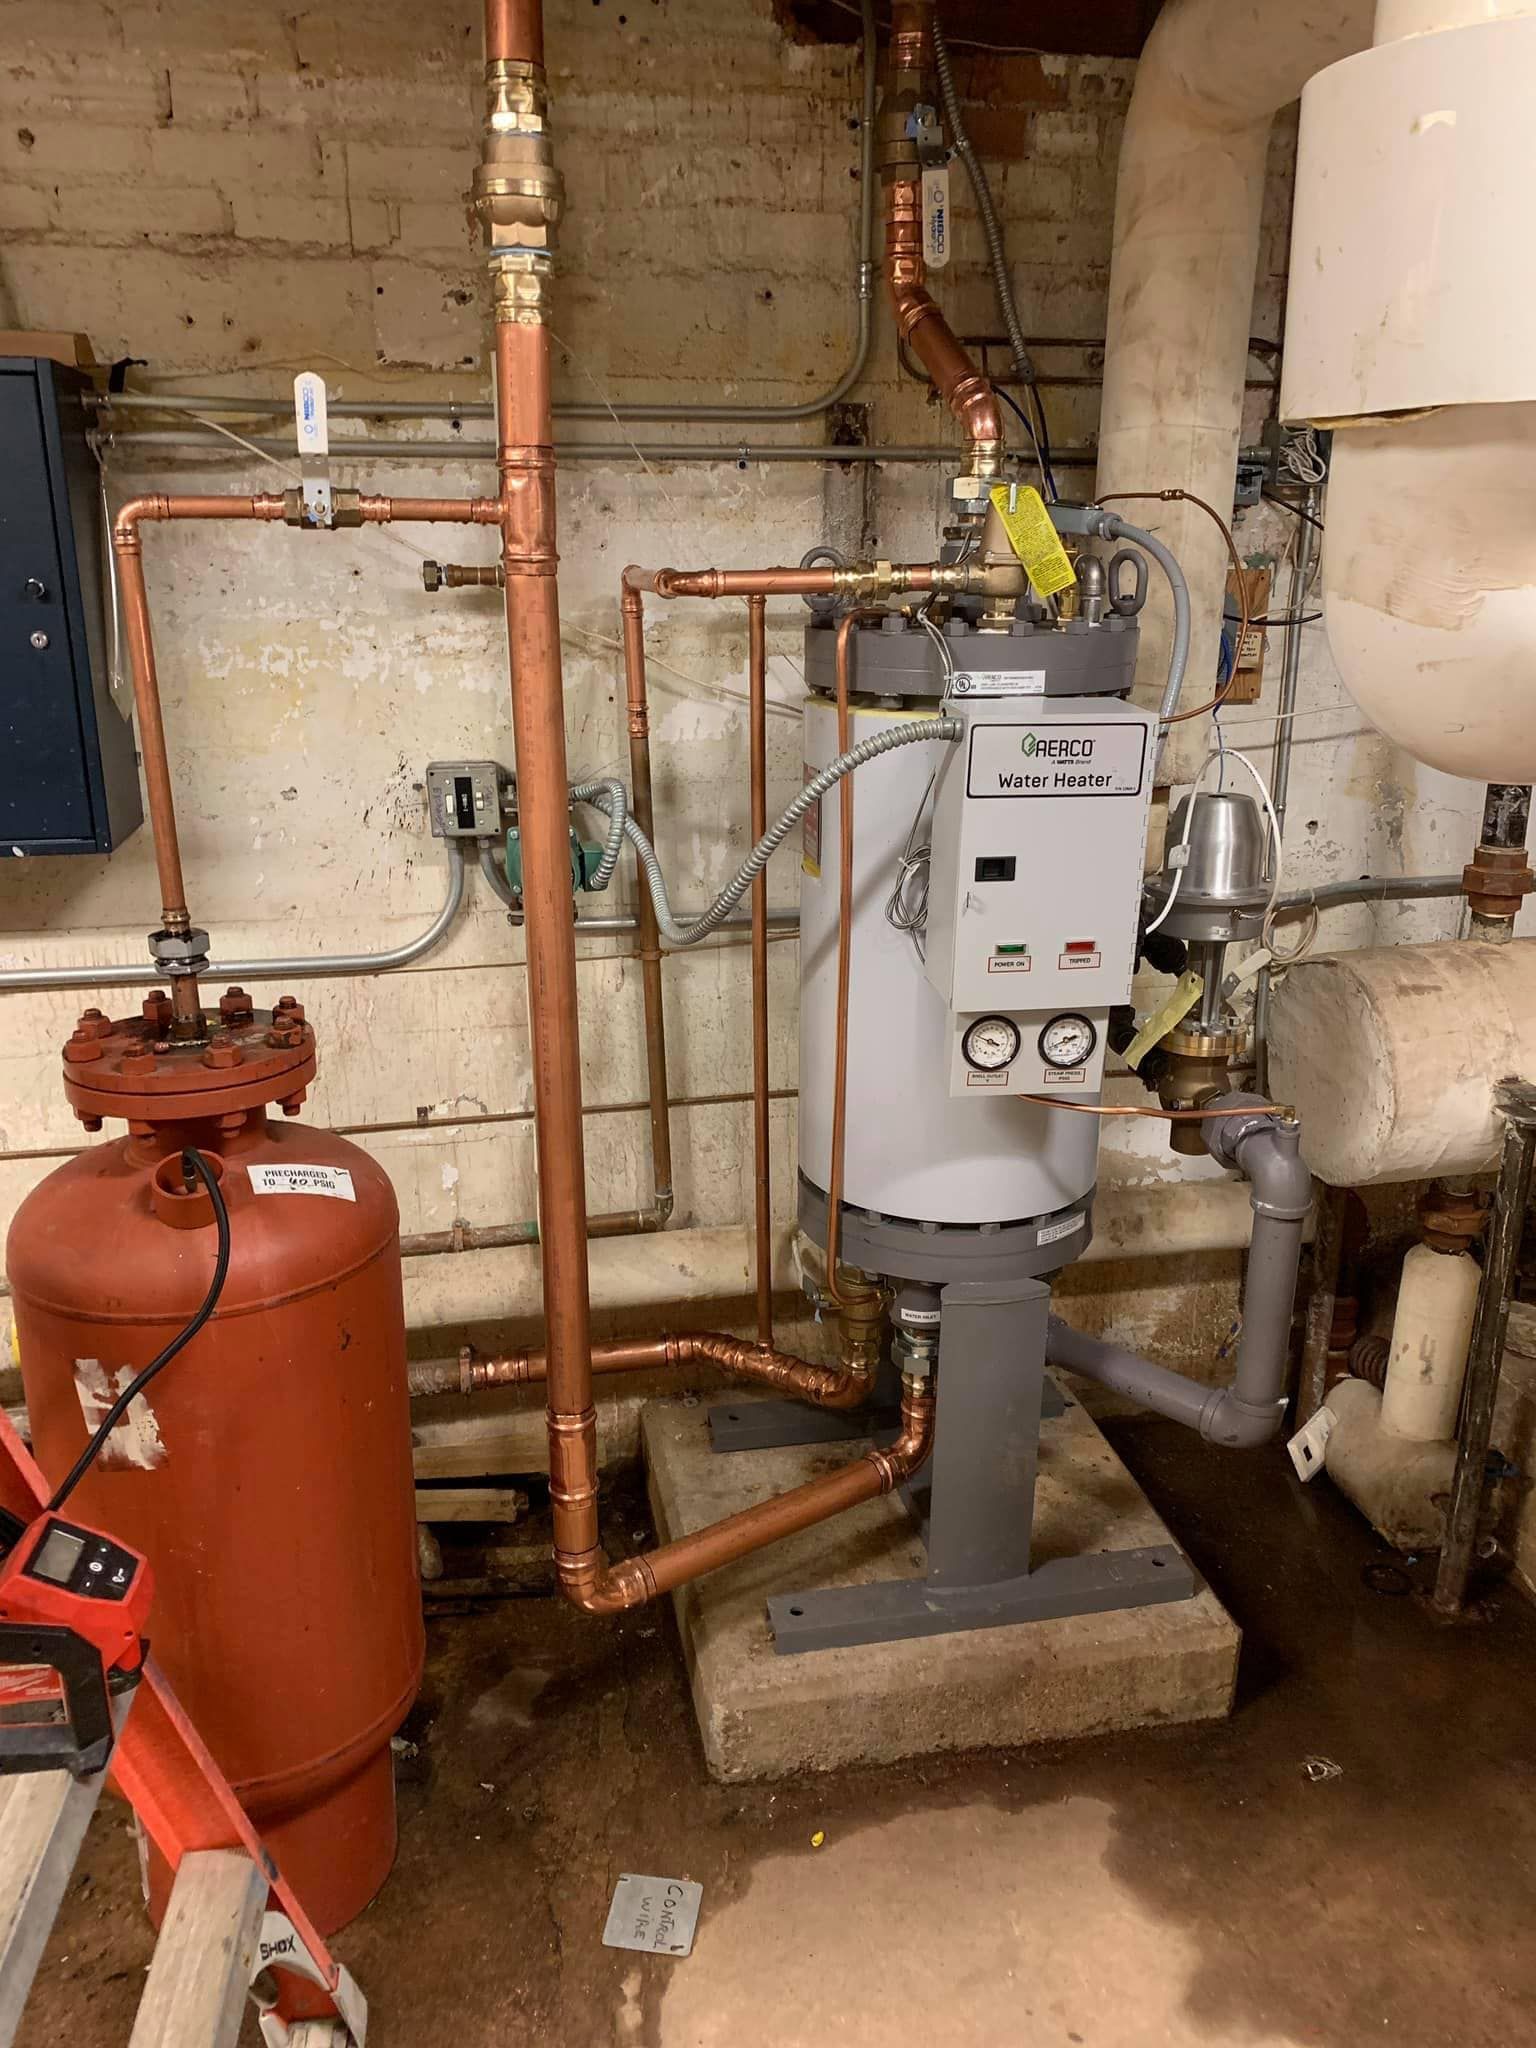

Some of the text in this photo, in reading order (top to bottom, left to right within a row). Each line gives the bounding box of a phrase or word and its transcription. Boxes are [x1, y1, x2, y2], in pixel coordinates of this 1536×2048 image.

[936, 208, 945, 254] NIBCO
[1035, 739, 1094, 758] AERCO
[998, 772, 1113, 788] Water Heater
[262, 1178, 276, 1187] TO
[313, 1179, 336, 1189] PSIG
[264, 1169, 328, 1179] PRECHARGED
[633, 1896, 653, 1940] WIRE
[259, 1934, 297, 1961] SHOX
